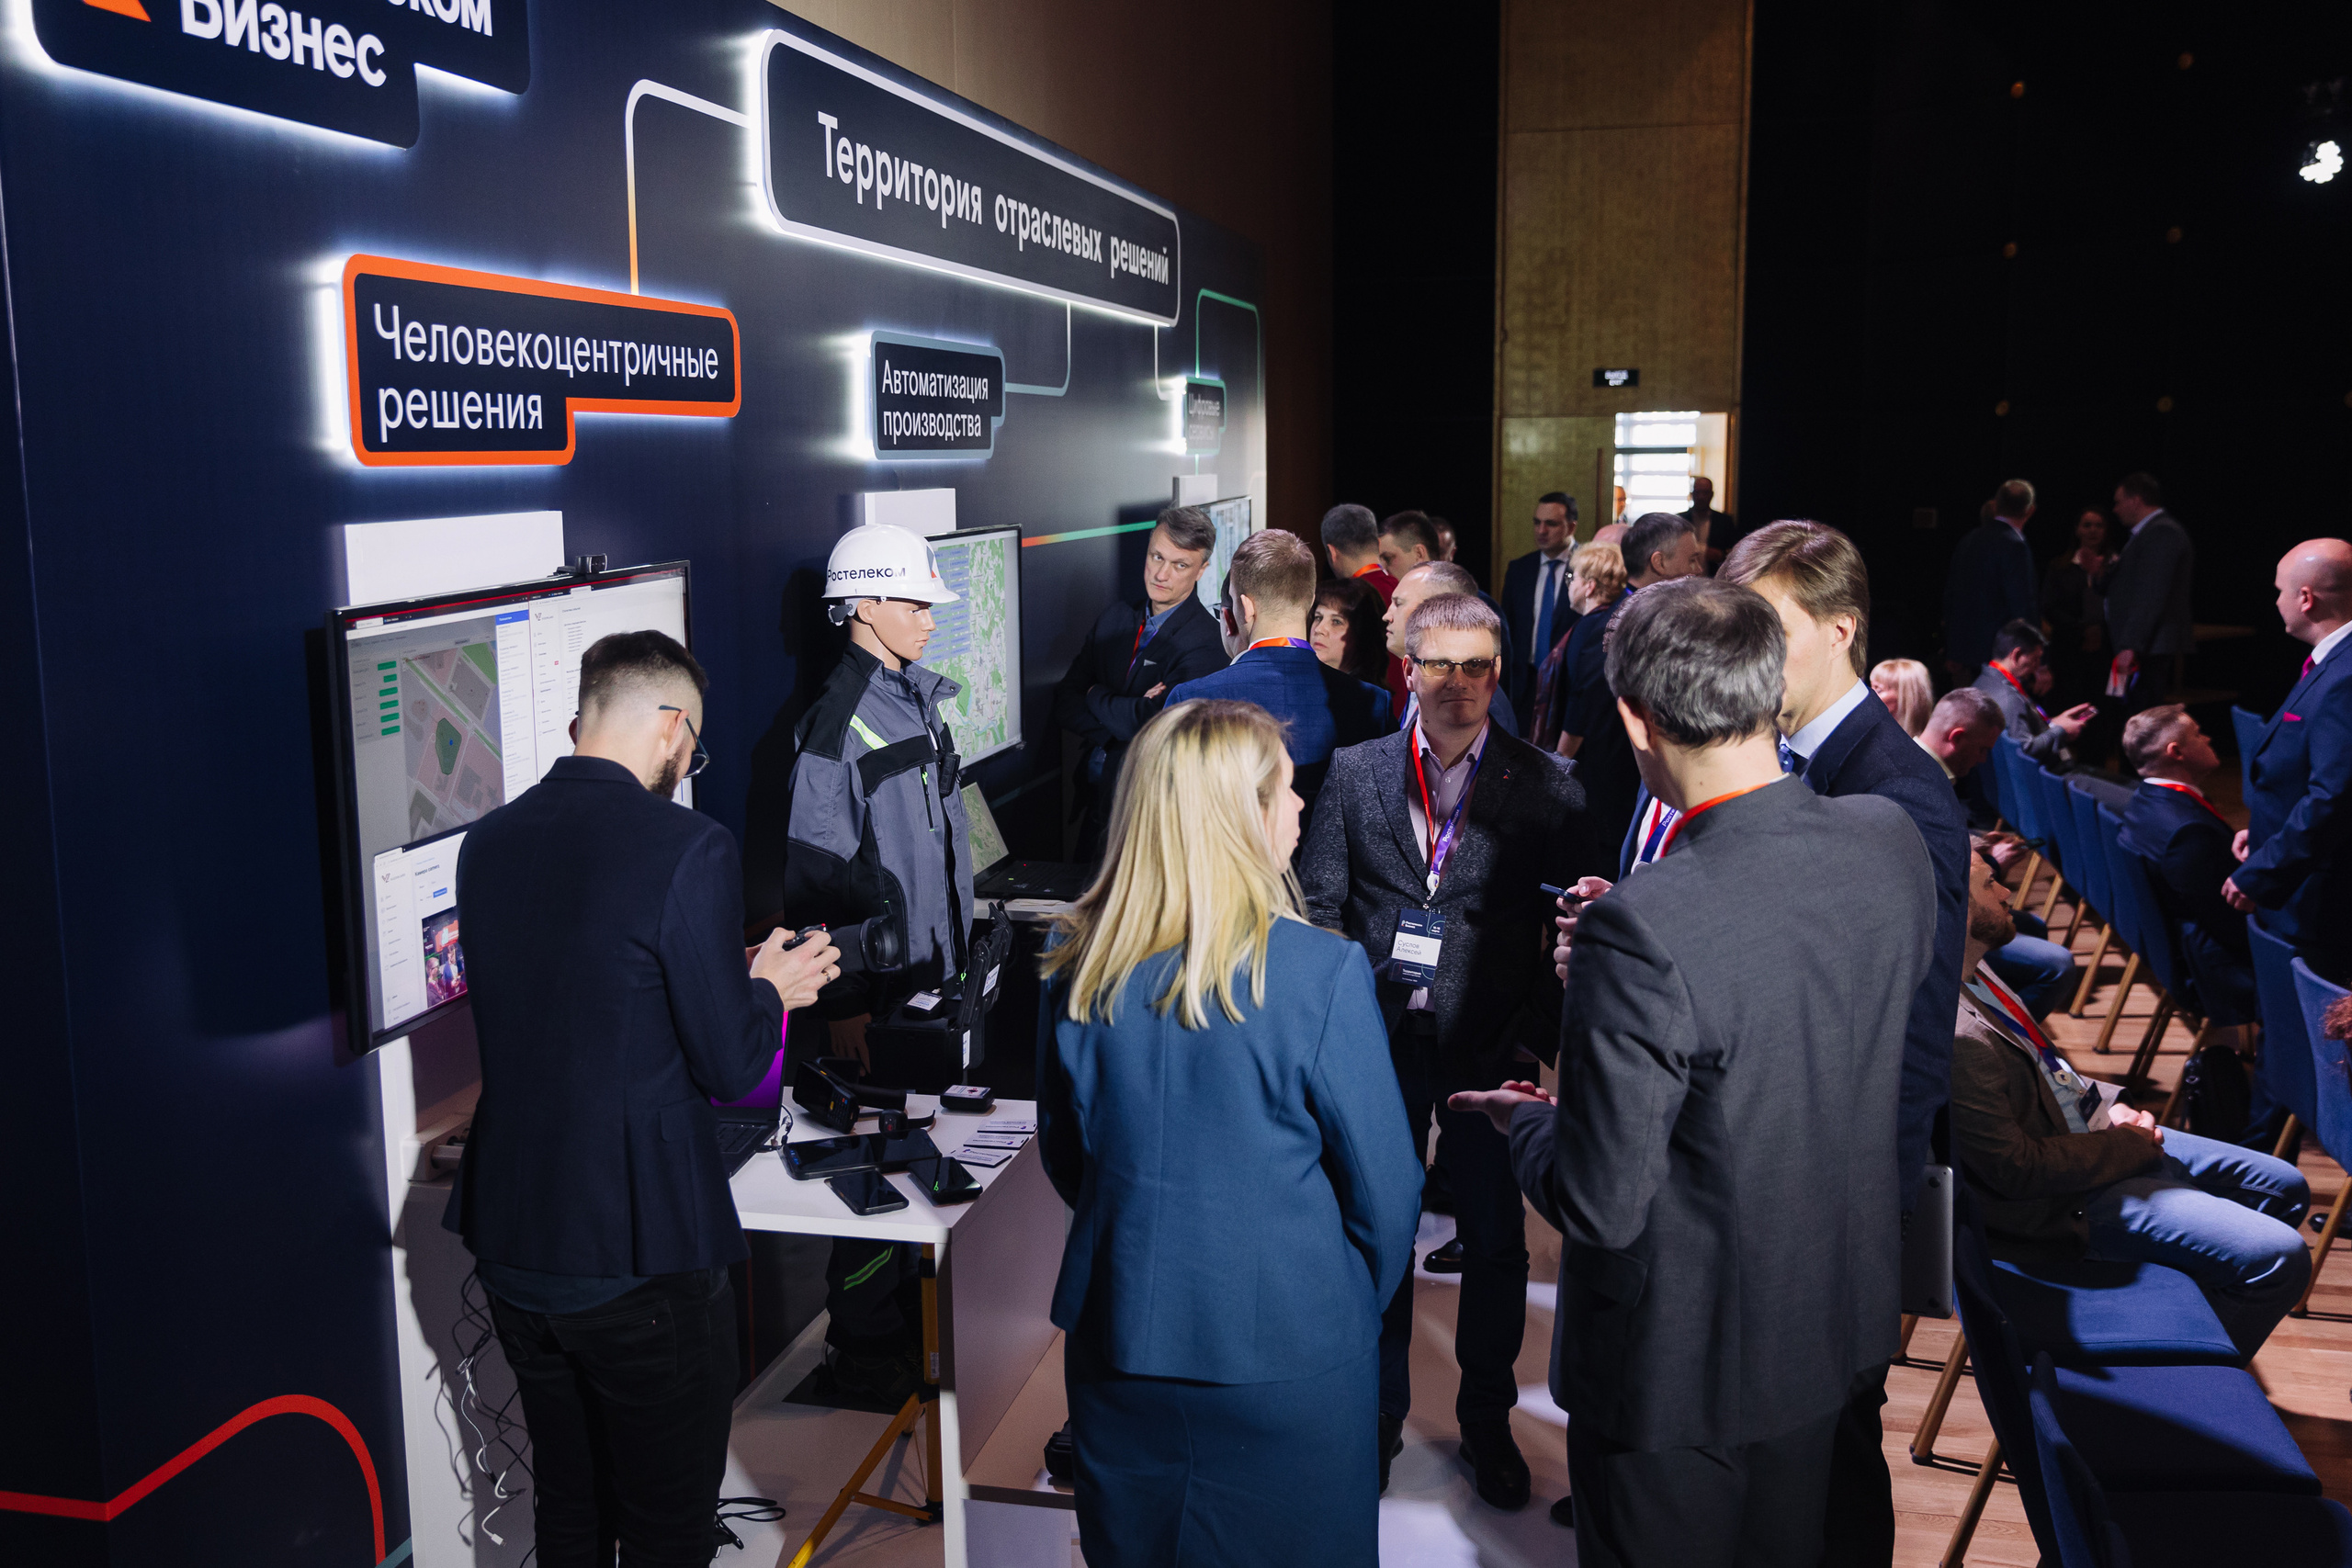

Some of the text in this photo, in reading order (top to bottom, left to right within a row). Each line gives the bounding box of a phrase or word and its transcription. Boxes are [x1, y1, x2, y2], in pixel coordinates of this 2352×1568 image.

[818, 111, 1169, 285] Территория отраслевых решений
[373, 302, 719, 386] Человекоцентричные
[882, 359, 989, 401] Автоматизация
[379, 388, 543, 443] решения
[883, 411, 982, 445] производства
[827, 567, 906, 582] Ростелеком
